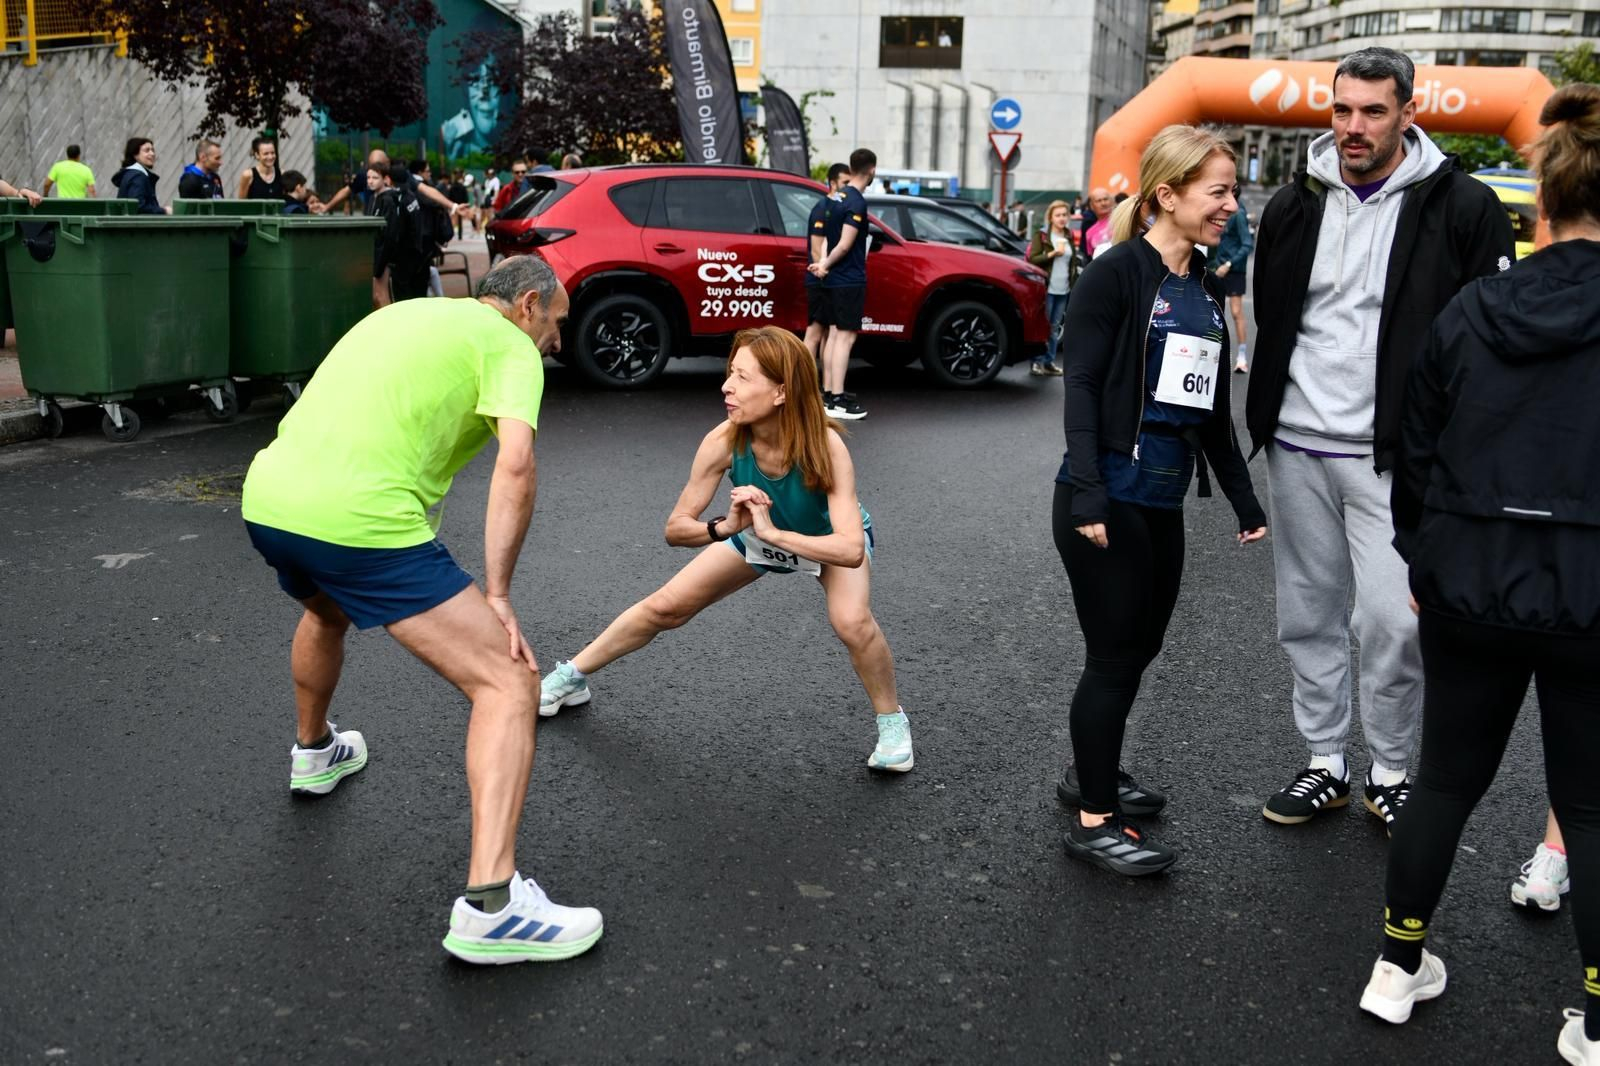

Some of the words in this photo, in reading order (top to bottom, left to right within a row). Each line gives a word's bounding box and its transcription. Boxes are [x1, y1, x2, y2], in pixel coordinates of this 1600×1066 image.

[1306, 76, 1467, 114] bdio
[697, 248, 738, 261] Nuevo
[697, 264, 775, 283] CX-5
[706, 286, 732, 299] tuyo
[735, 286, 768, 297] desde
[700, 300, 774, 318] 29.990€
[1182, 372, 1211, 396] 601
[762, 547, 799, 565] 501
